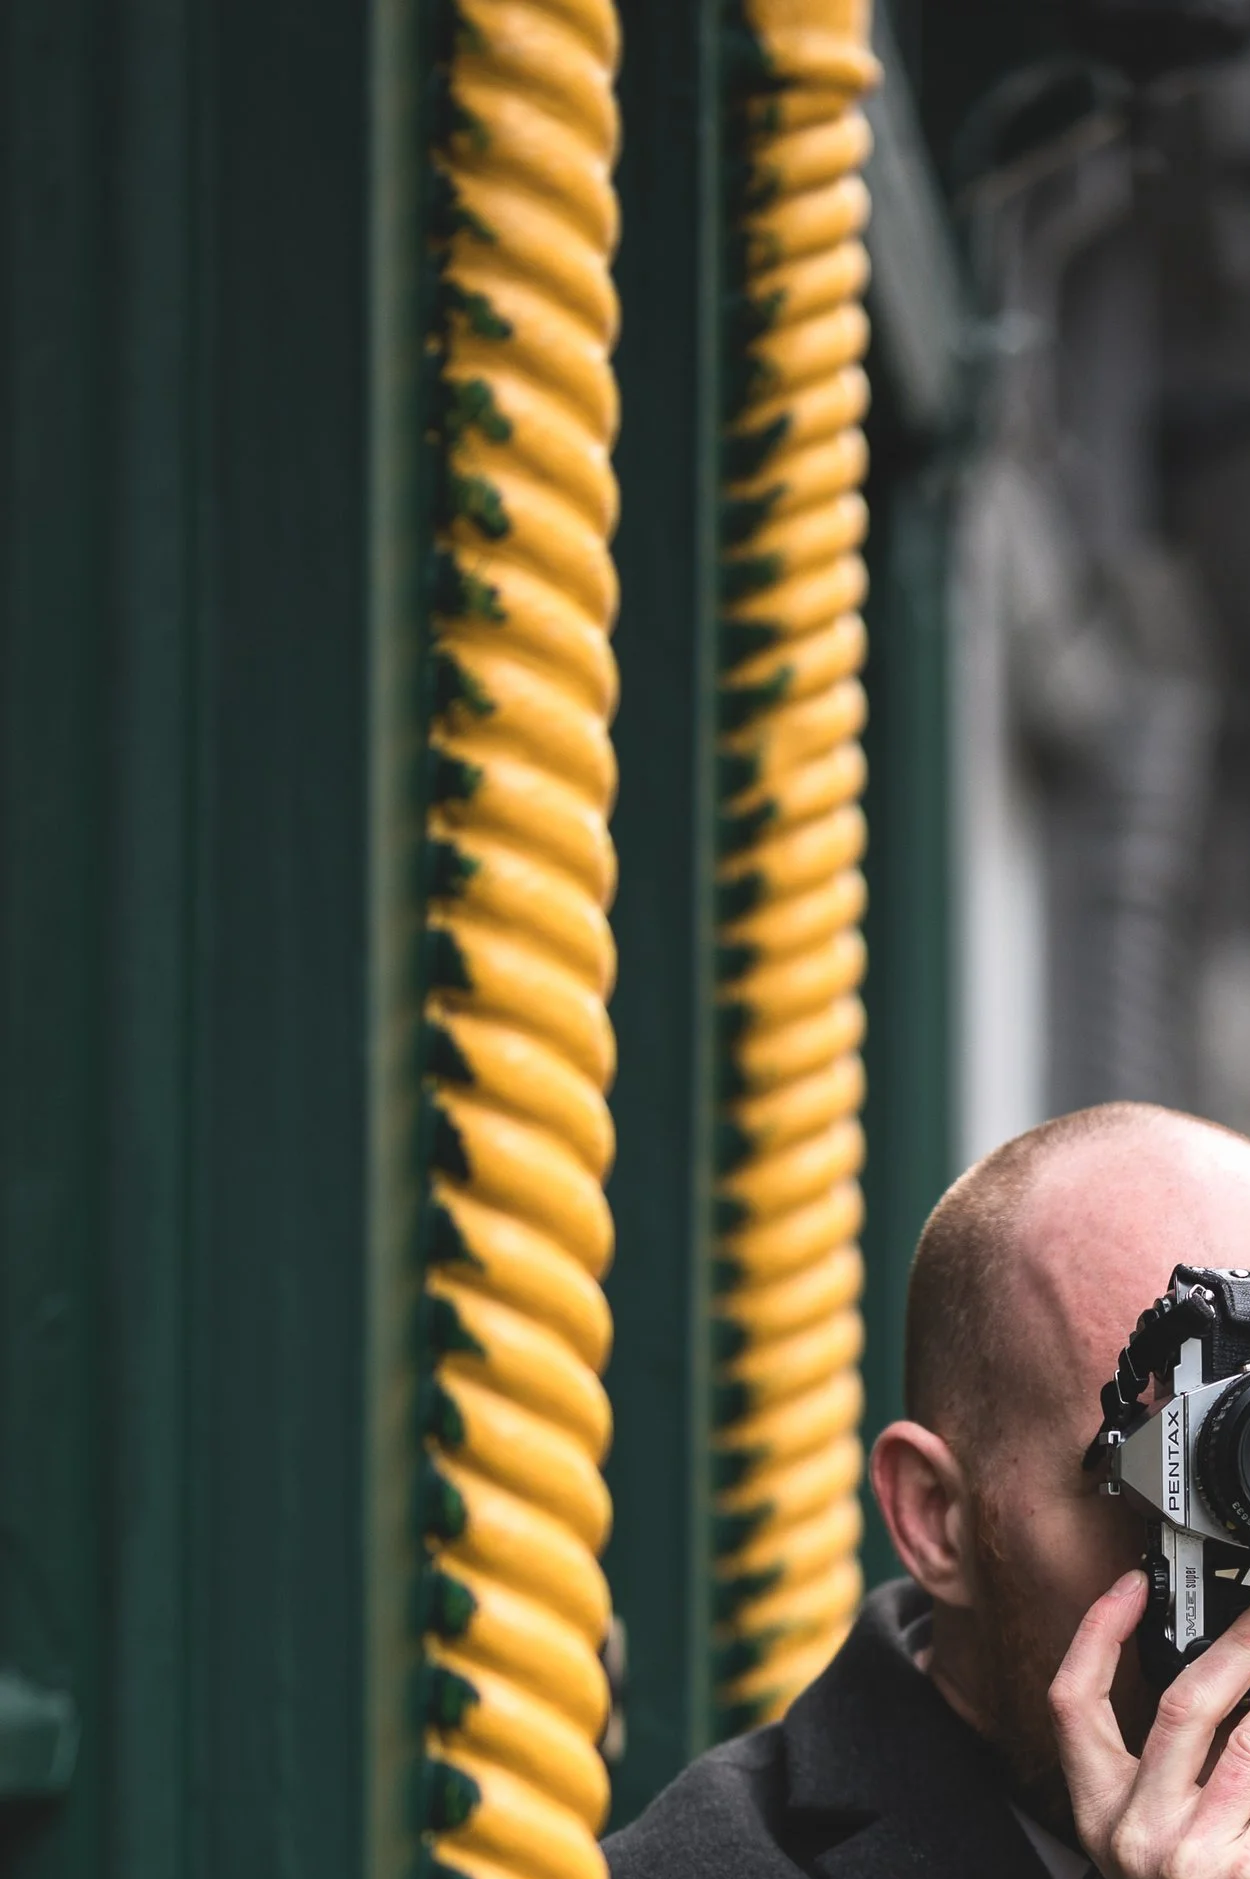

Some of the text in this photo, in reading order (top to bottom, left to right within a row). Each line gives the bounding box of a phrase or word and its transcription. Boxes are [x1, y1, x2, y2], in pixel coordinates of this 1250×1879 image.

[1168, 1410, 1180, 1511] PENTAX
[1186, 1566, 1200, 1637] ME super
